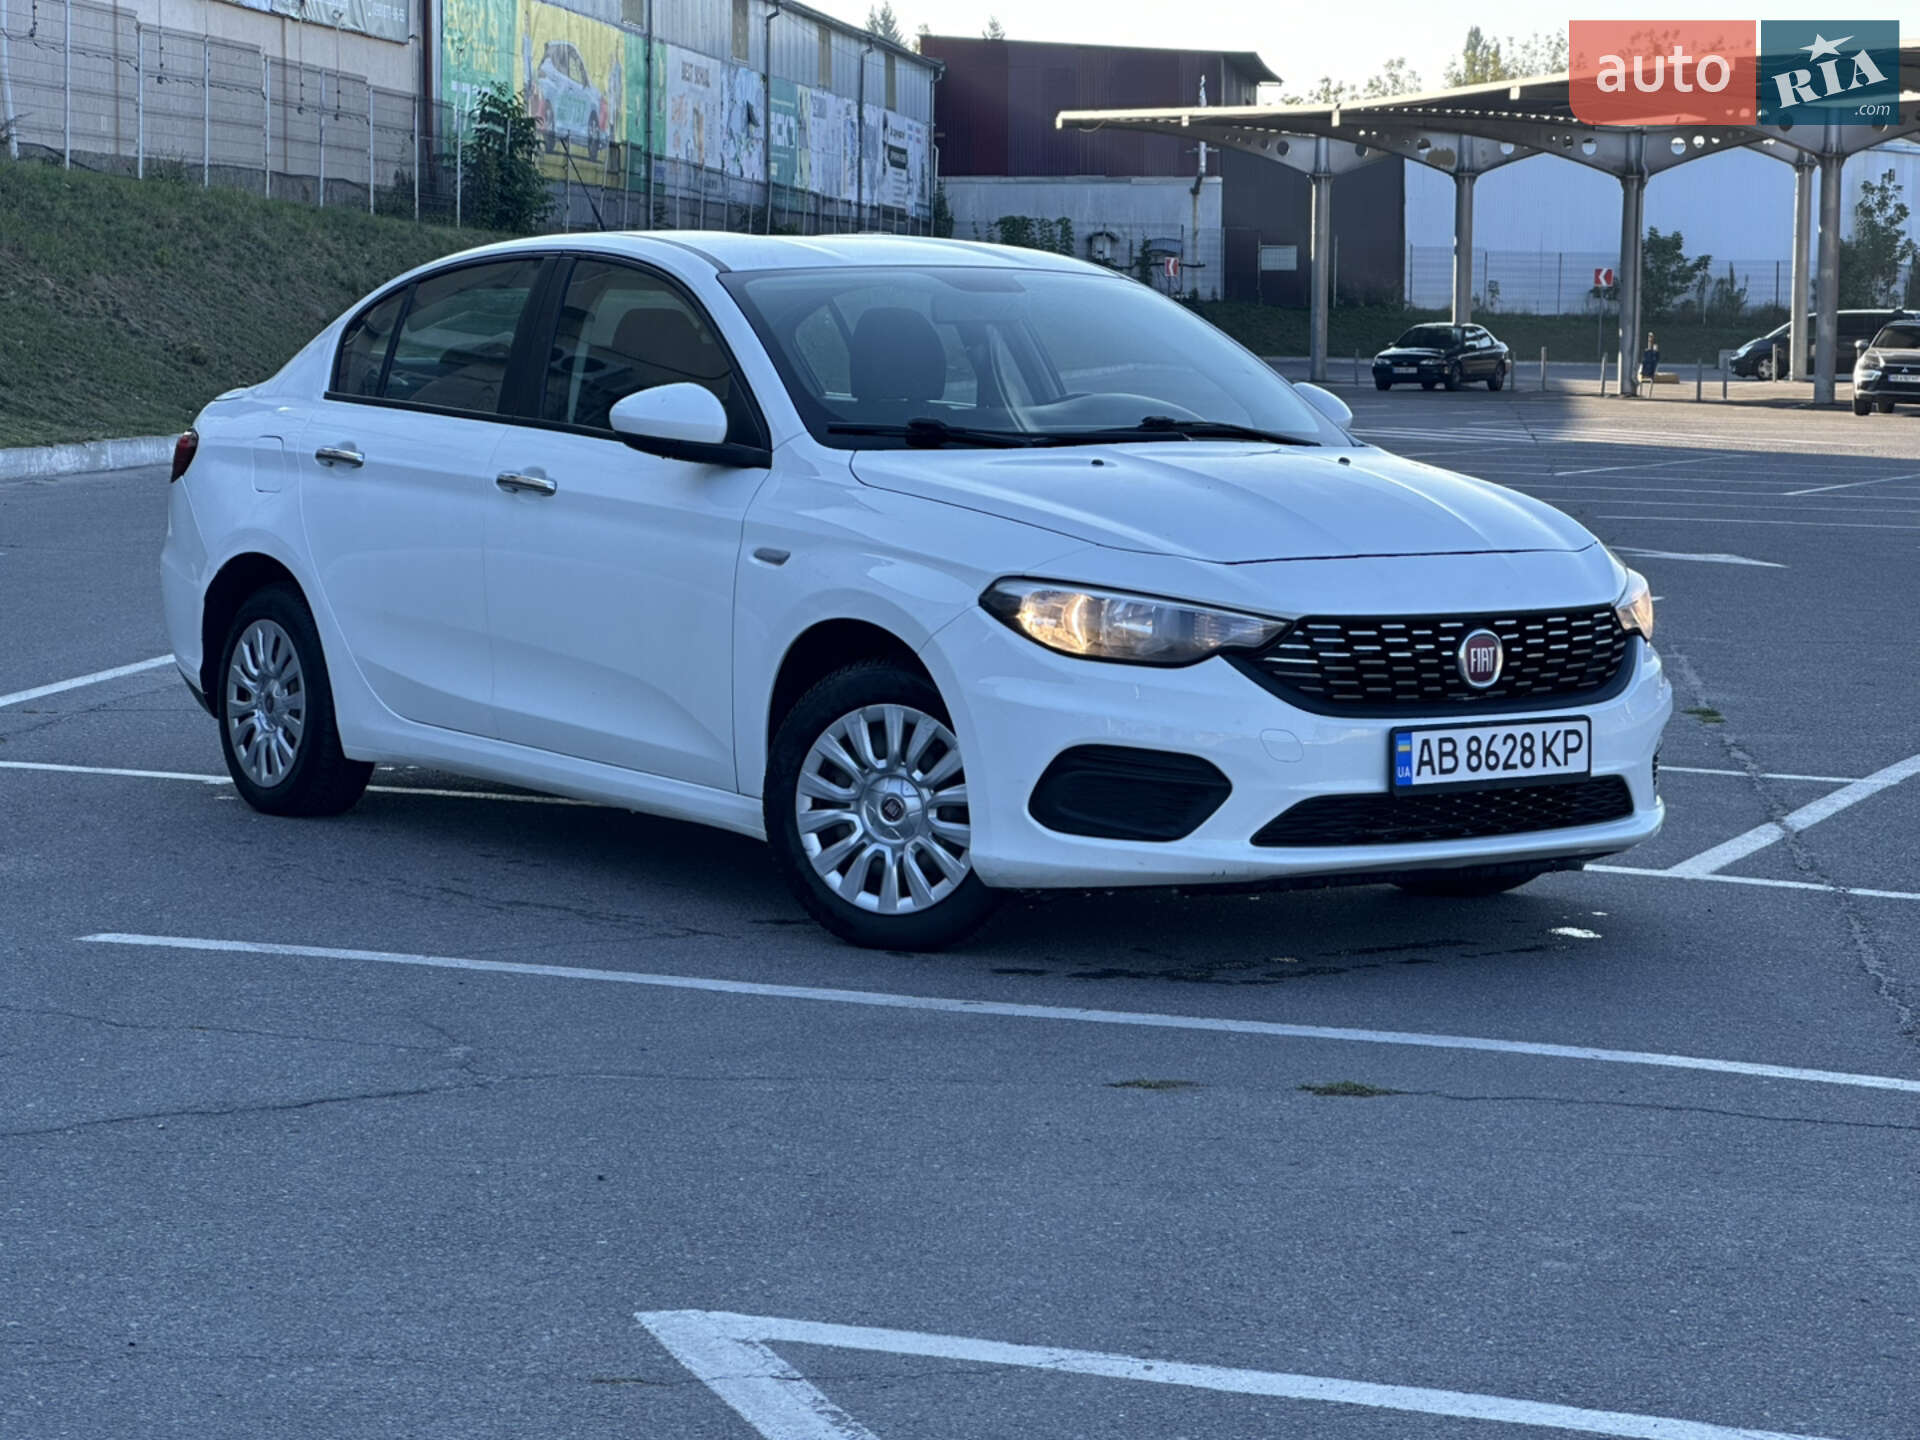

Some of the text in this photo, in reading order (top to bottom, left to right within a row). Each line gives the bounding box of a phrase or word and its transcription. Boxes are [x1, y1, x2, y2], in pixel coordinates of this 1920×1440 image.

[1470, 647, 1495, 673] FIAT
[1416, 728, 1584, 777] AB 8628 KP
[1397, 766, 1411, 778] UA
